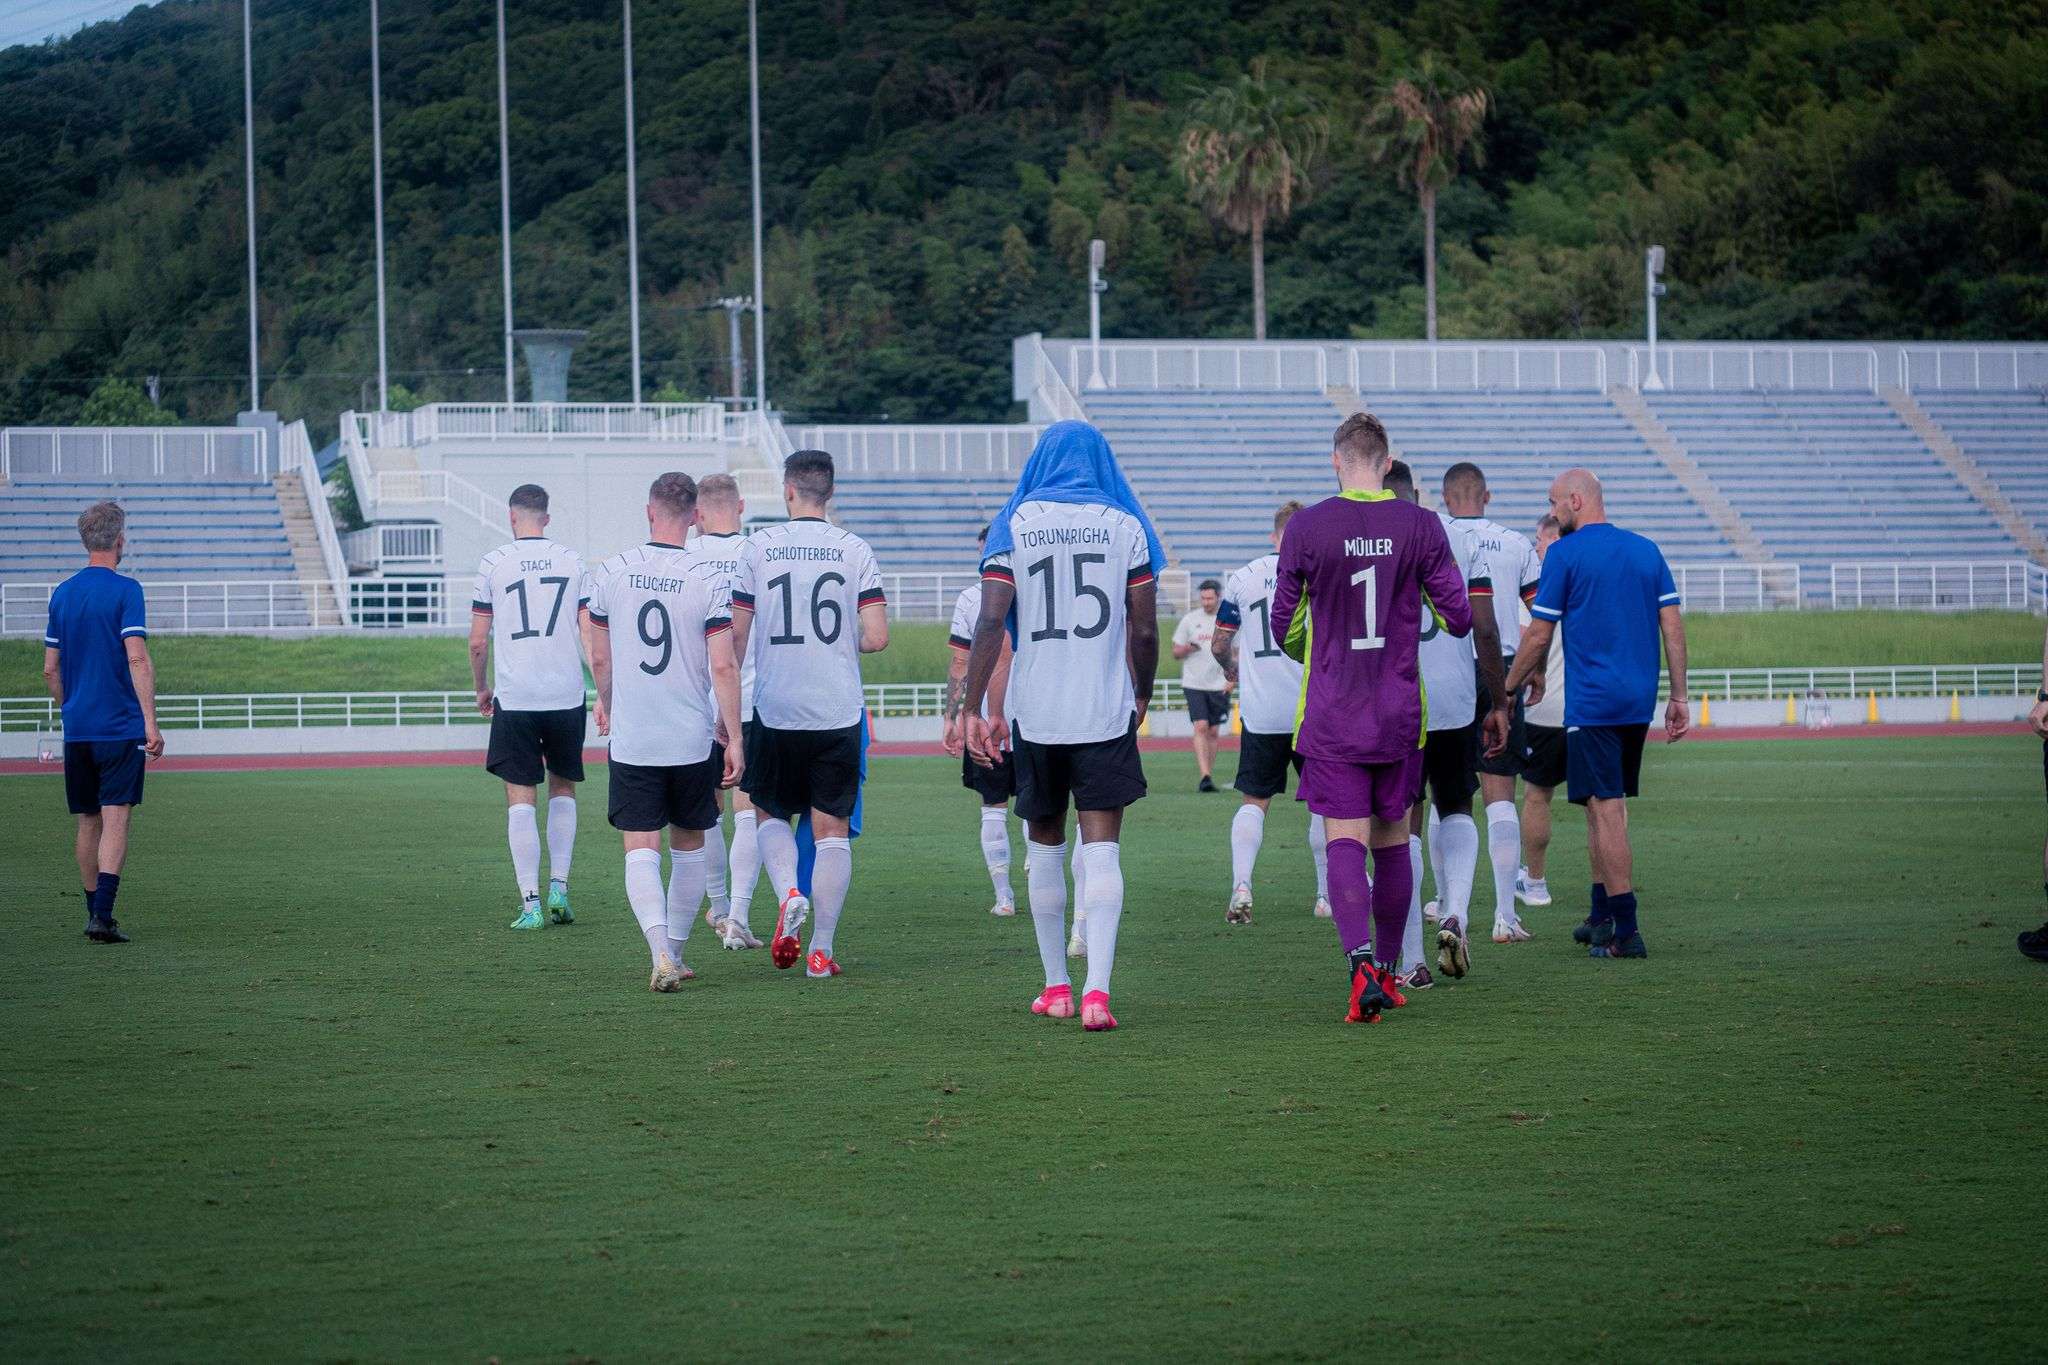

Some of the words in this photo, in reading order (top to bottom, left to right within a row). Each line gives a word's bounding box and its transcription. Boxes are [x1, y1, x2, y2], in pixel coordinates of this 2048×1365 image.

[765, 546, 844, 562] SCHLOTTERBECK
[1021, 527, 1110, 549] TORUNARIGHA
[1344, 536, 1393, 557] MÜLLER
[520, 559, 552, 572] STACH
[629, 574, 685, 594] TEUCHERT
[505, 576, 570, 640] 17
[767, 571, 846, 646] 16
[1028, 552, 1111, 642] 15
[1350, 564, 1386, 650] 1
[637, 599, 673, 676] 9
